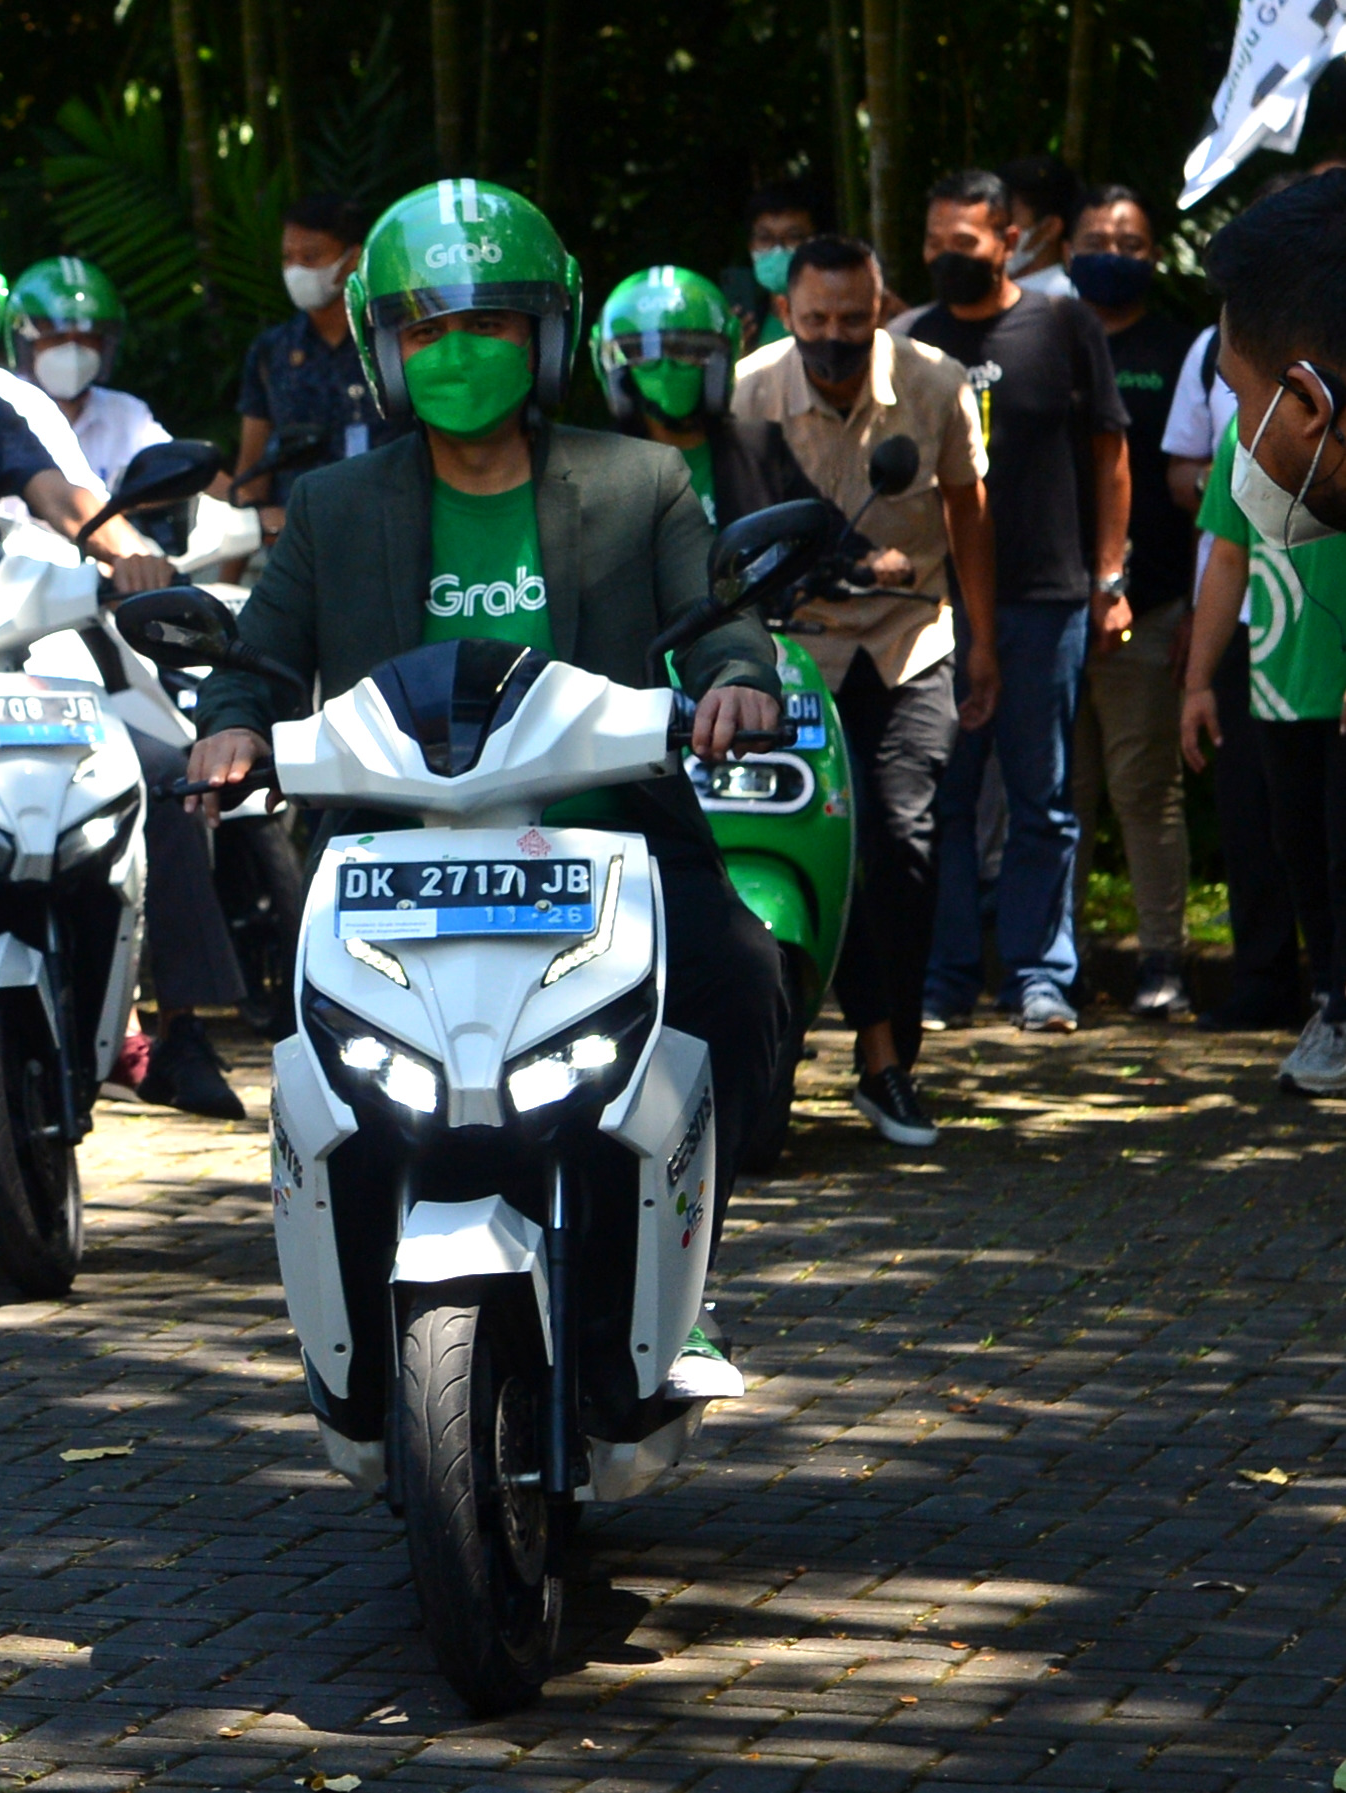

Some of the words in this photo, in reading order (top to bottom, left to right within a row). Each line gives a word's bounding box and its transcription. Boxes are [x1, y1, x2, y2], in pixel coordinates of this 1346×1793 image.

[425, 236, 503, 269] Grab
[425, 565, 547, 617] Grab
[62, 697, 95, 721] JB
[345, 868, 394, 898] DK
[541, 865, 589, 893] JB
